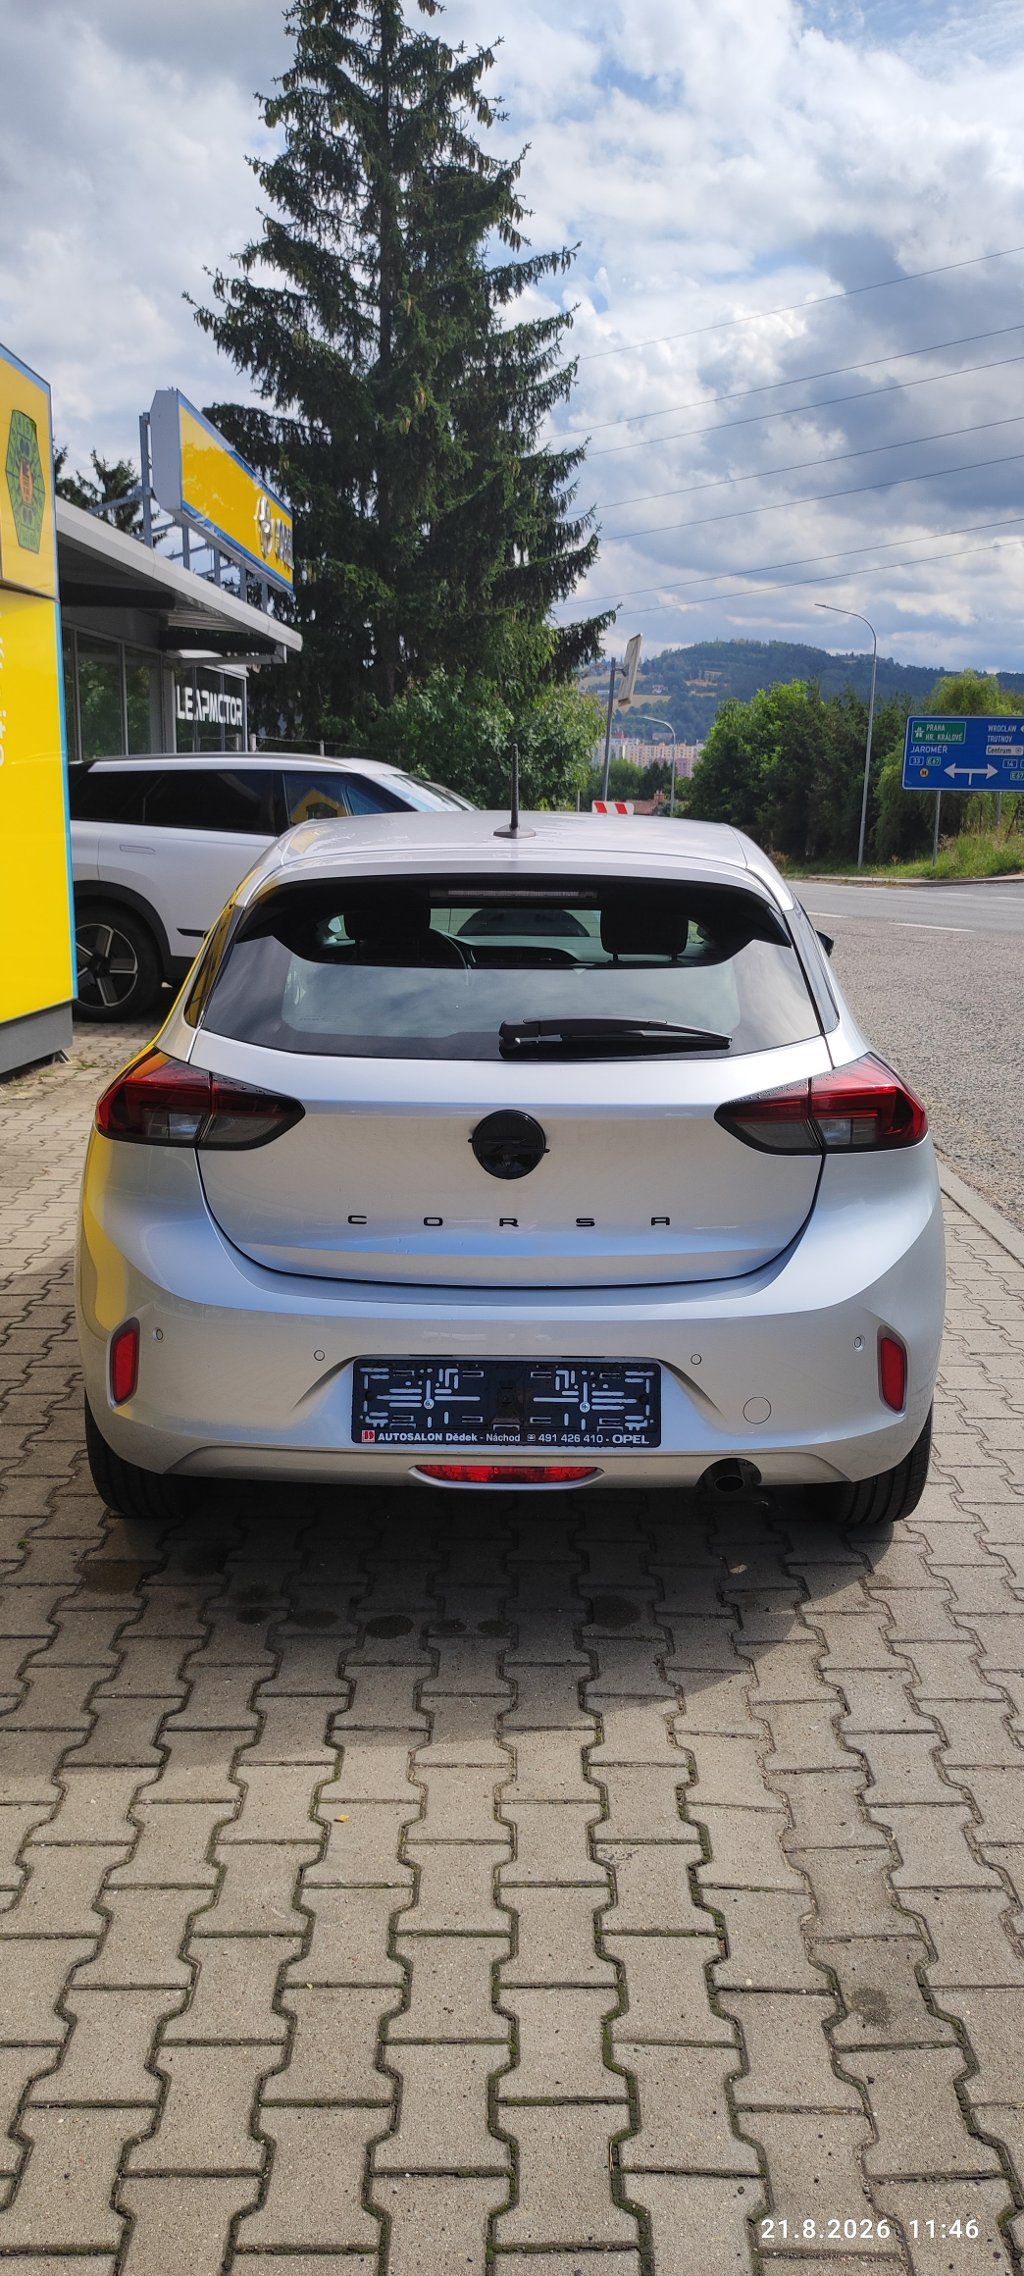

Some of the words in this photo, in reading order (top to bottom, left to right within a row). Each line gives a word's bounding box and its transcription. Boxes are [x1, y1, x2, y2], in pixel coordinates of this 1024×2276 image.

[926, 723, 945, 732] PRAHA
[987, 735, 1013, 744] TRUTNOV
[988, 746, 1012, 755] Centrum
[347, 1214, 671, 1228] CORSA
[378, 1432, 443, 1442] AUTOSALON
[445, 1431, 478, 1442] Dědek
[486, 1432, 521, 1442] Náchod
[538, 1434, 557, 1443] 491
[560, 1434, 581, 1443] 426
[583, 1434, 604, 1443] 410
[612, 1434, 650, 1444] OPEL
